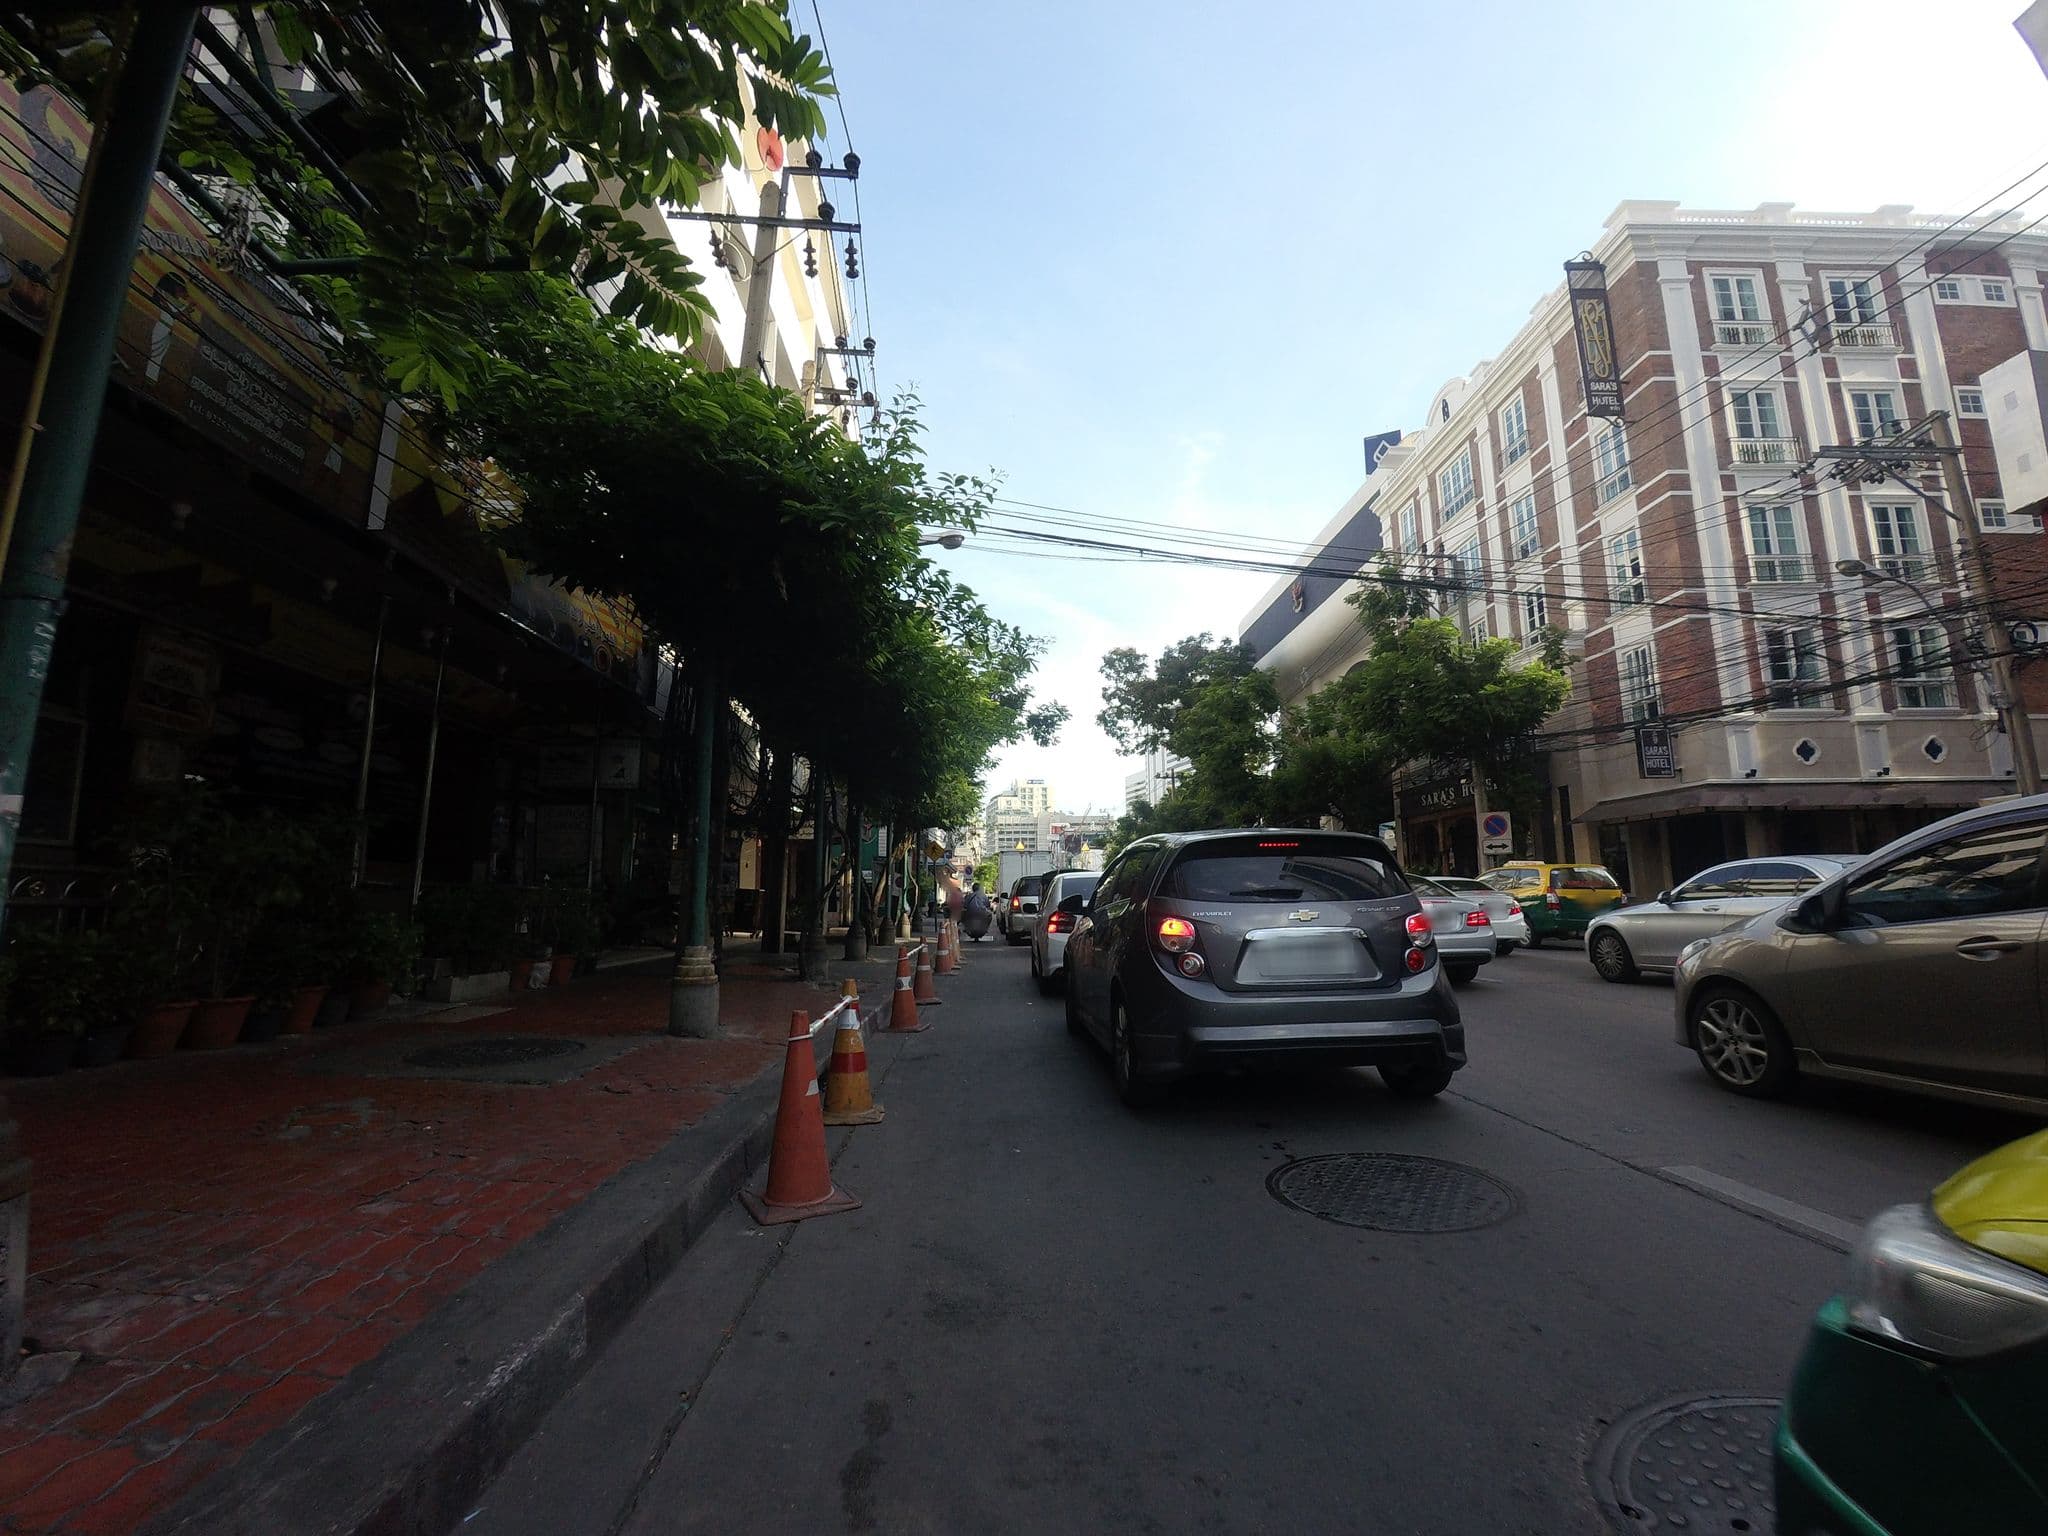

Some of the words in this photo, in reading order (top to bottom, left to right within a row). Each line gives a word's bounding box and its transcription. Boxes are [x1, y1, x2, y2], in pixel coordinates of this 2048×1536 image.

[1590, 381, 1618, 391] SARA'S
[1591, 396, 1620, 405] HOTEL
[1646, 758, 1671, 768] HOTEL
[1421, 786, 1455, 808] SARA'S
